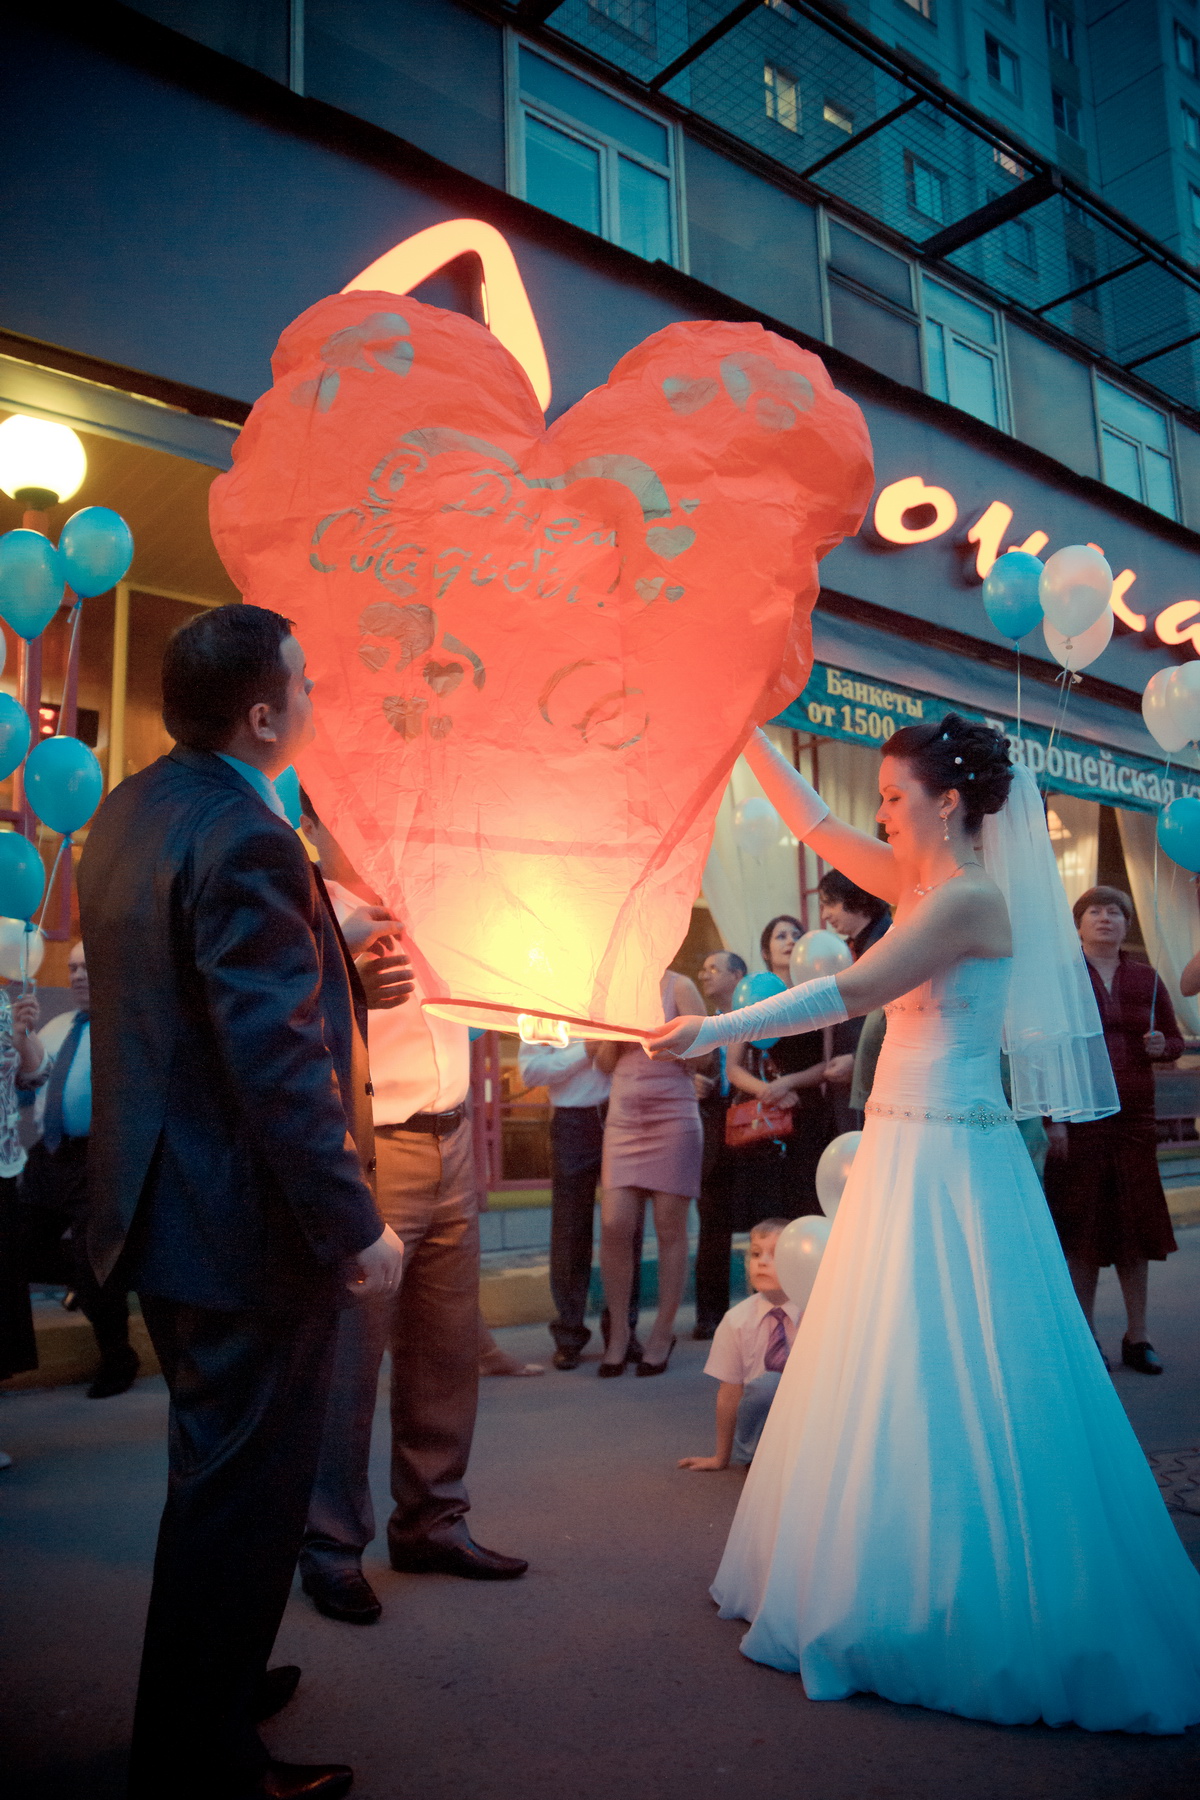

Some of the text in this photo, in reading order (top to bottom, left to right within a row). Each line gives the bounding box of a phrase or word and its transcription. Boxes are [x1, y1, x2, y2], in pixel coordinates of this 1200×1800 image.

[826, 668, 924, 719] Банкеты
[808, 702, 896, 741] от 1500
